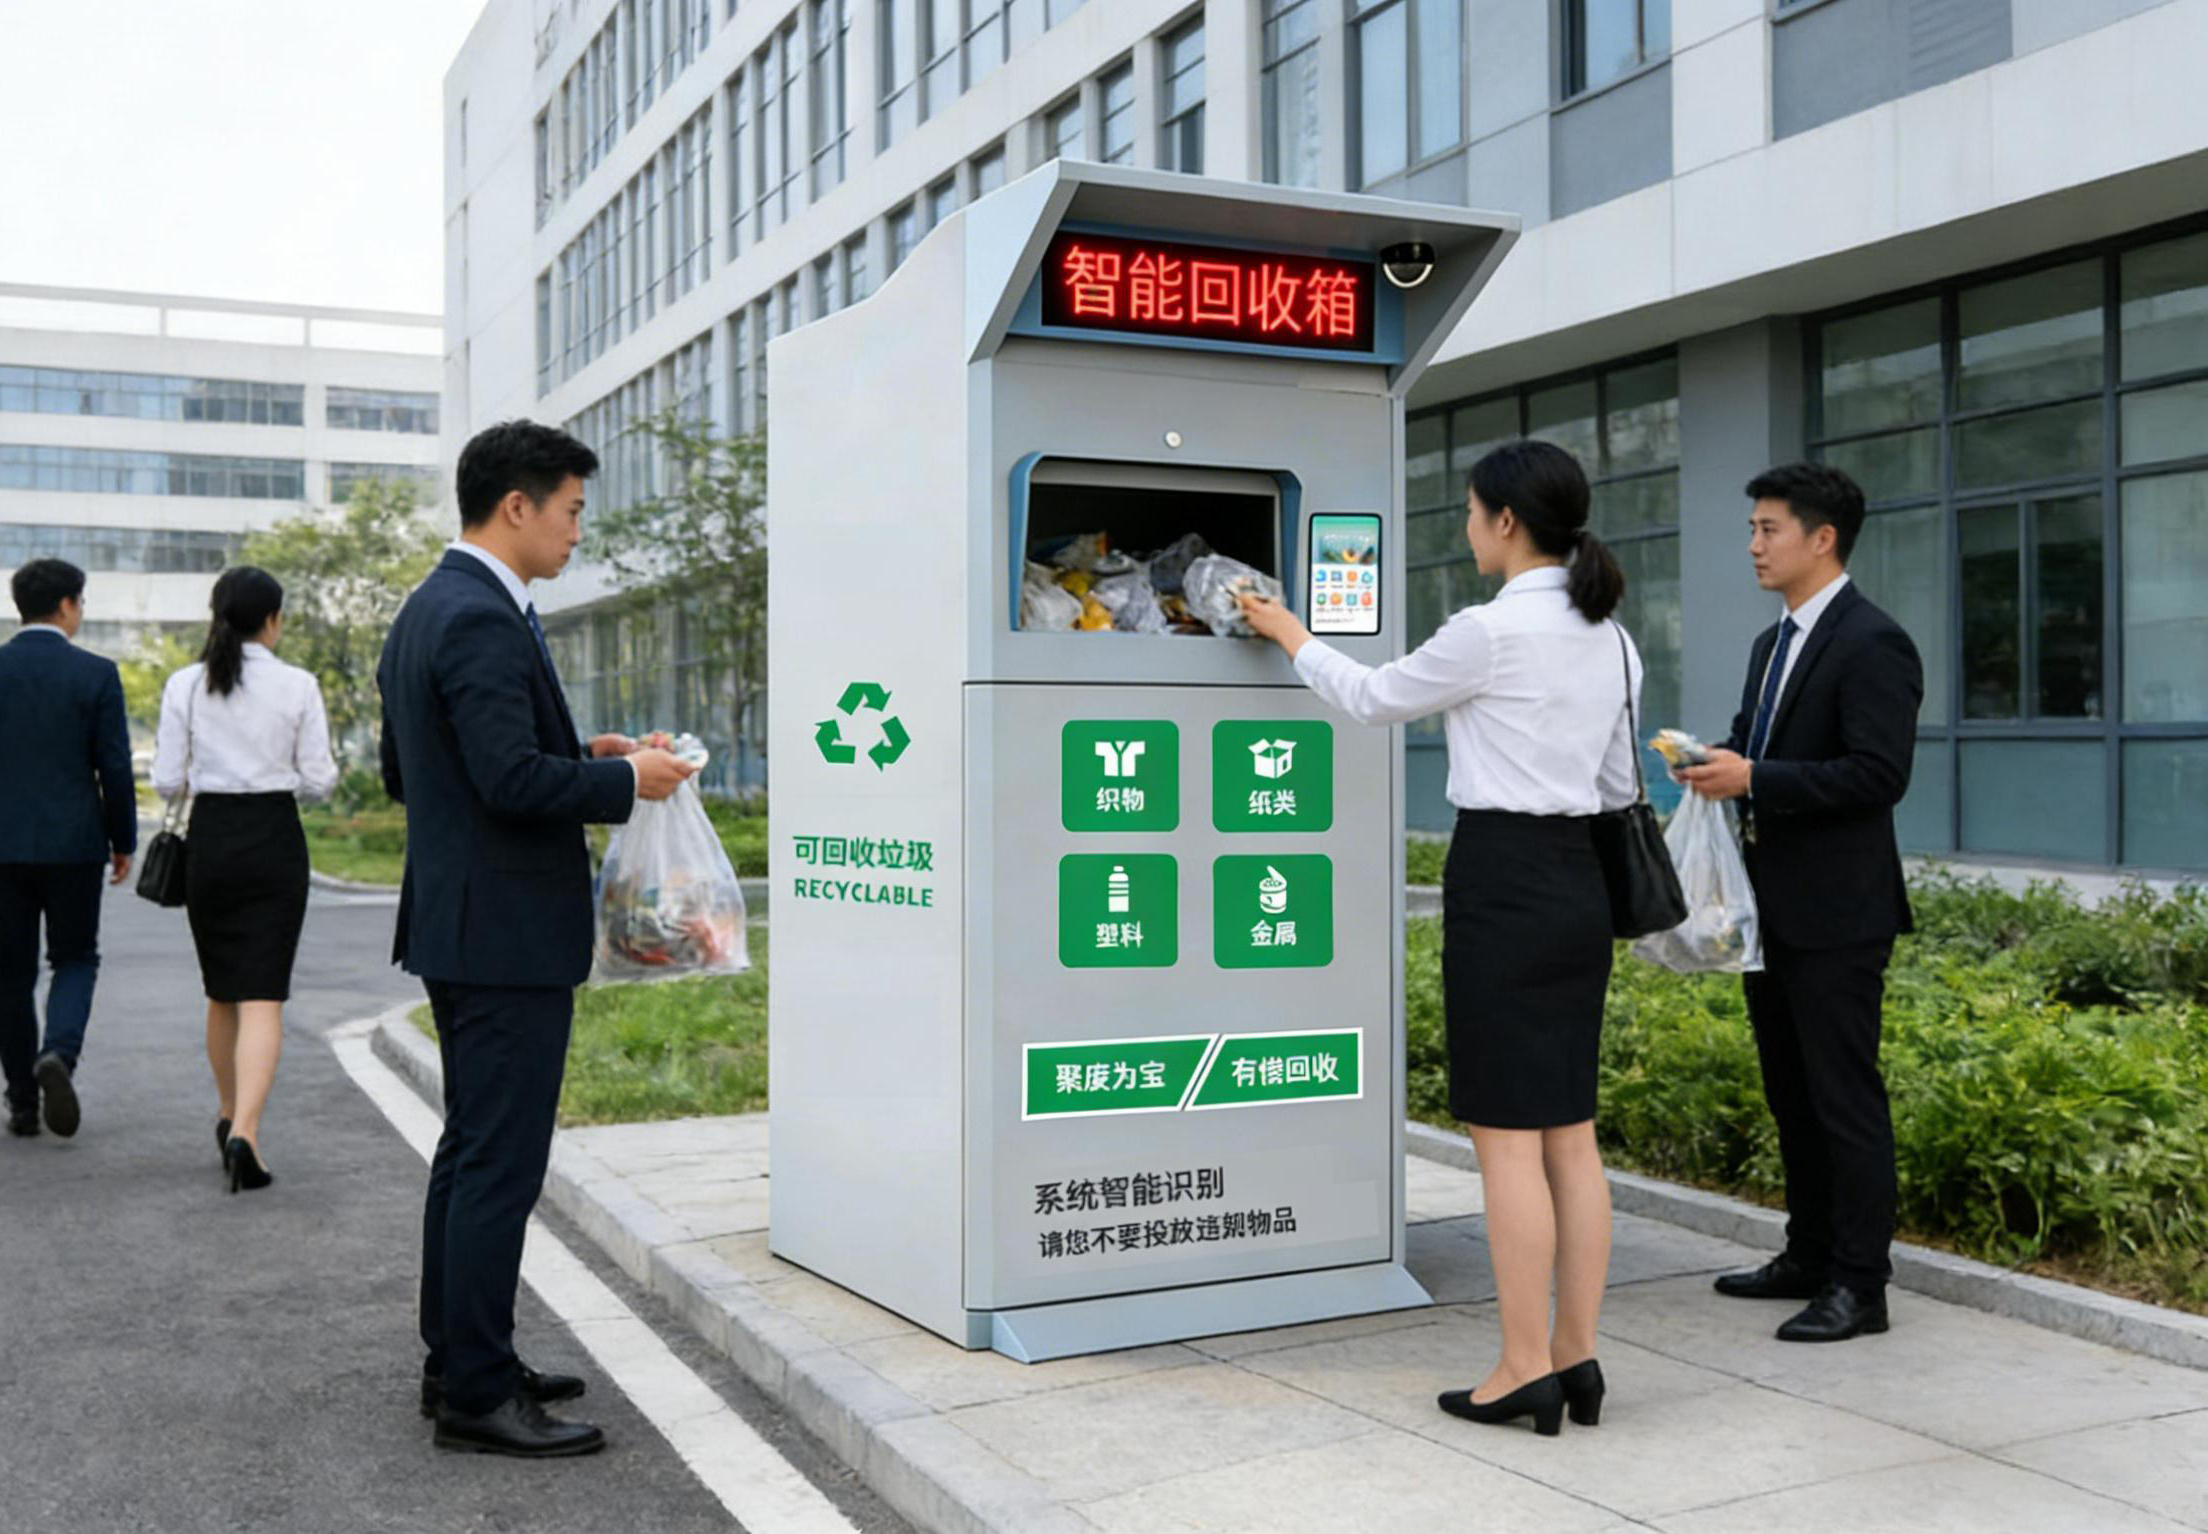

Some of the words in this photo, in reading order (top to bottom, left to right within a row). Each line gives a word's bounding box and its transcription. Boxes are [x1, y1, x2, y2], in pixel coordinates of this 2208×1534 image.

[1062, 245, 1359, 337] 智能回收箱
[1095, 787, 1145, 813] 织物
[1248, 789, 1297, 816] 纸类
[792, 836, 934, 871] 可回收垃圾
[794, 878, 933, 907] RECYCLABLE
[1095, 920, 1144, 948] 塑料
[1250, 919, 1297, 946] 金属
[1055, 1060, 1166, 1094] 聚废为宝
[1034, 1166, 1225, 1215] 系统智能识别
